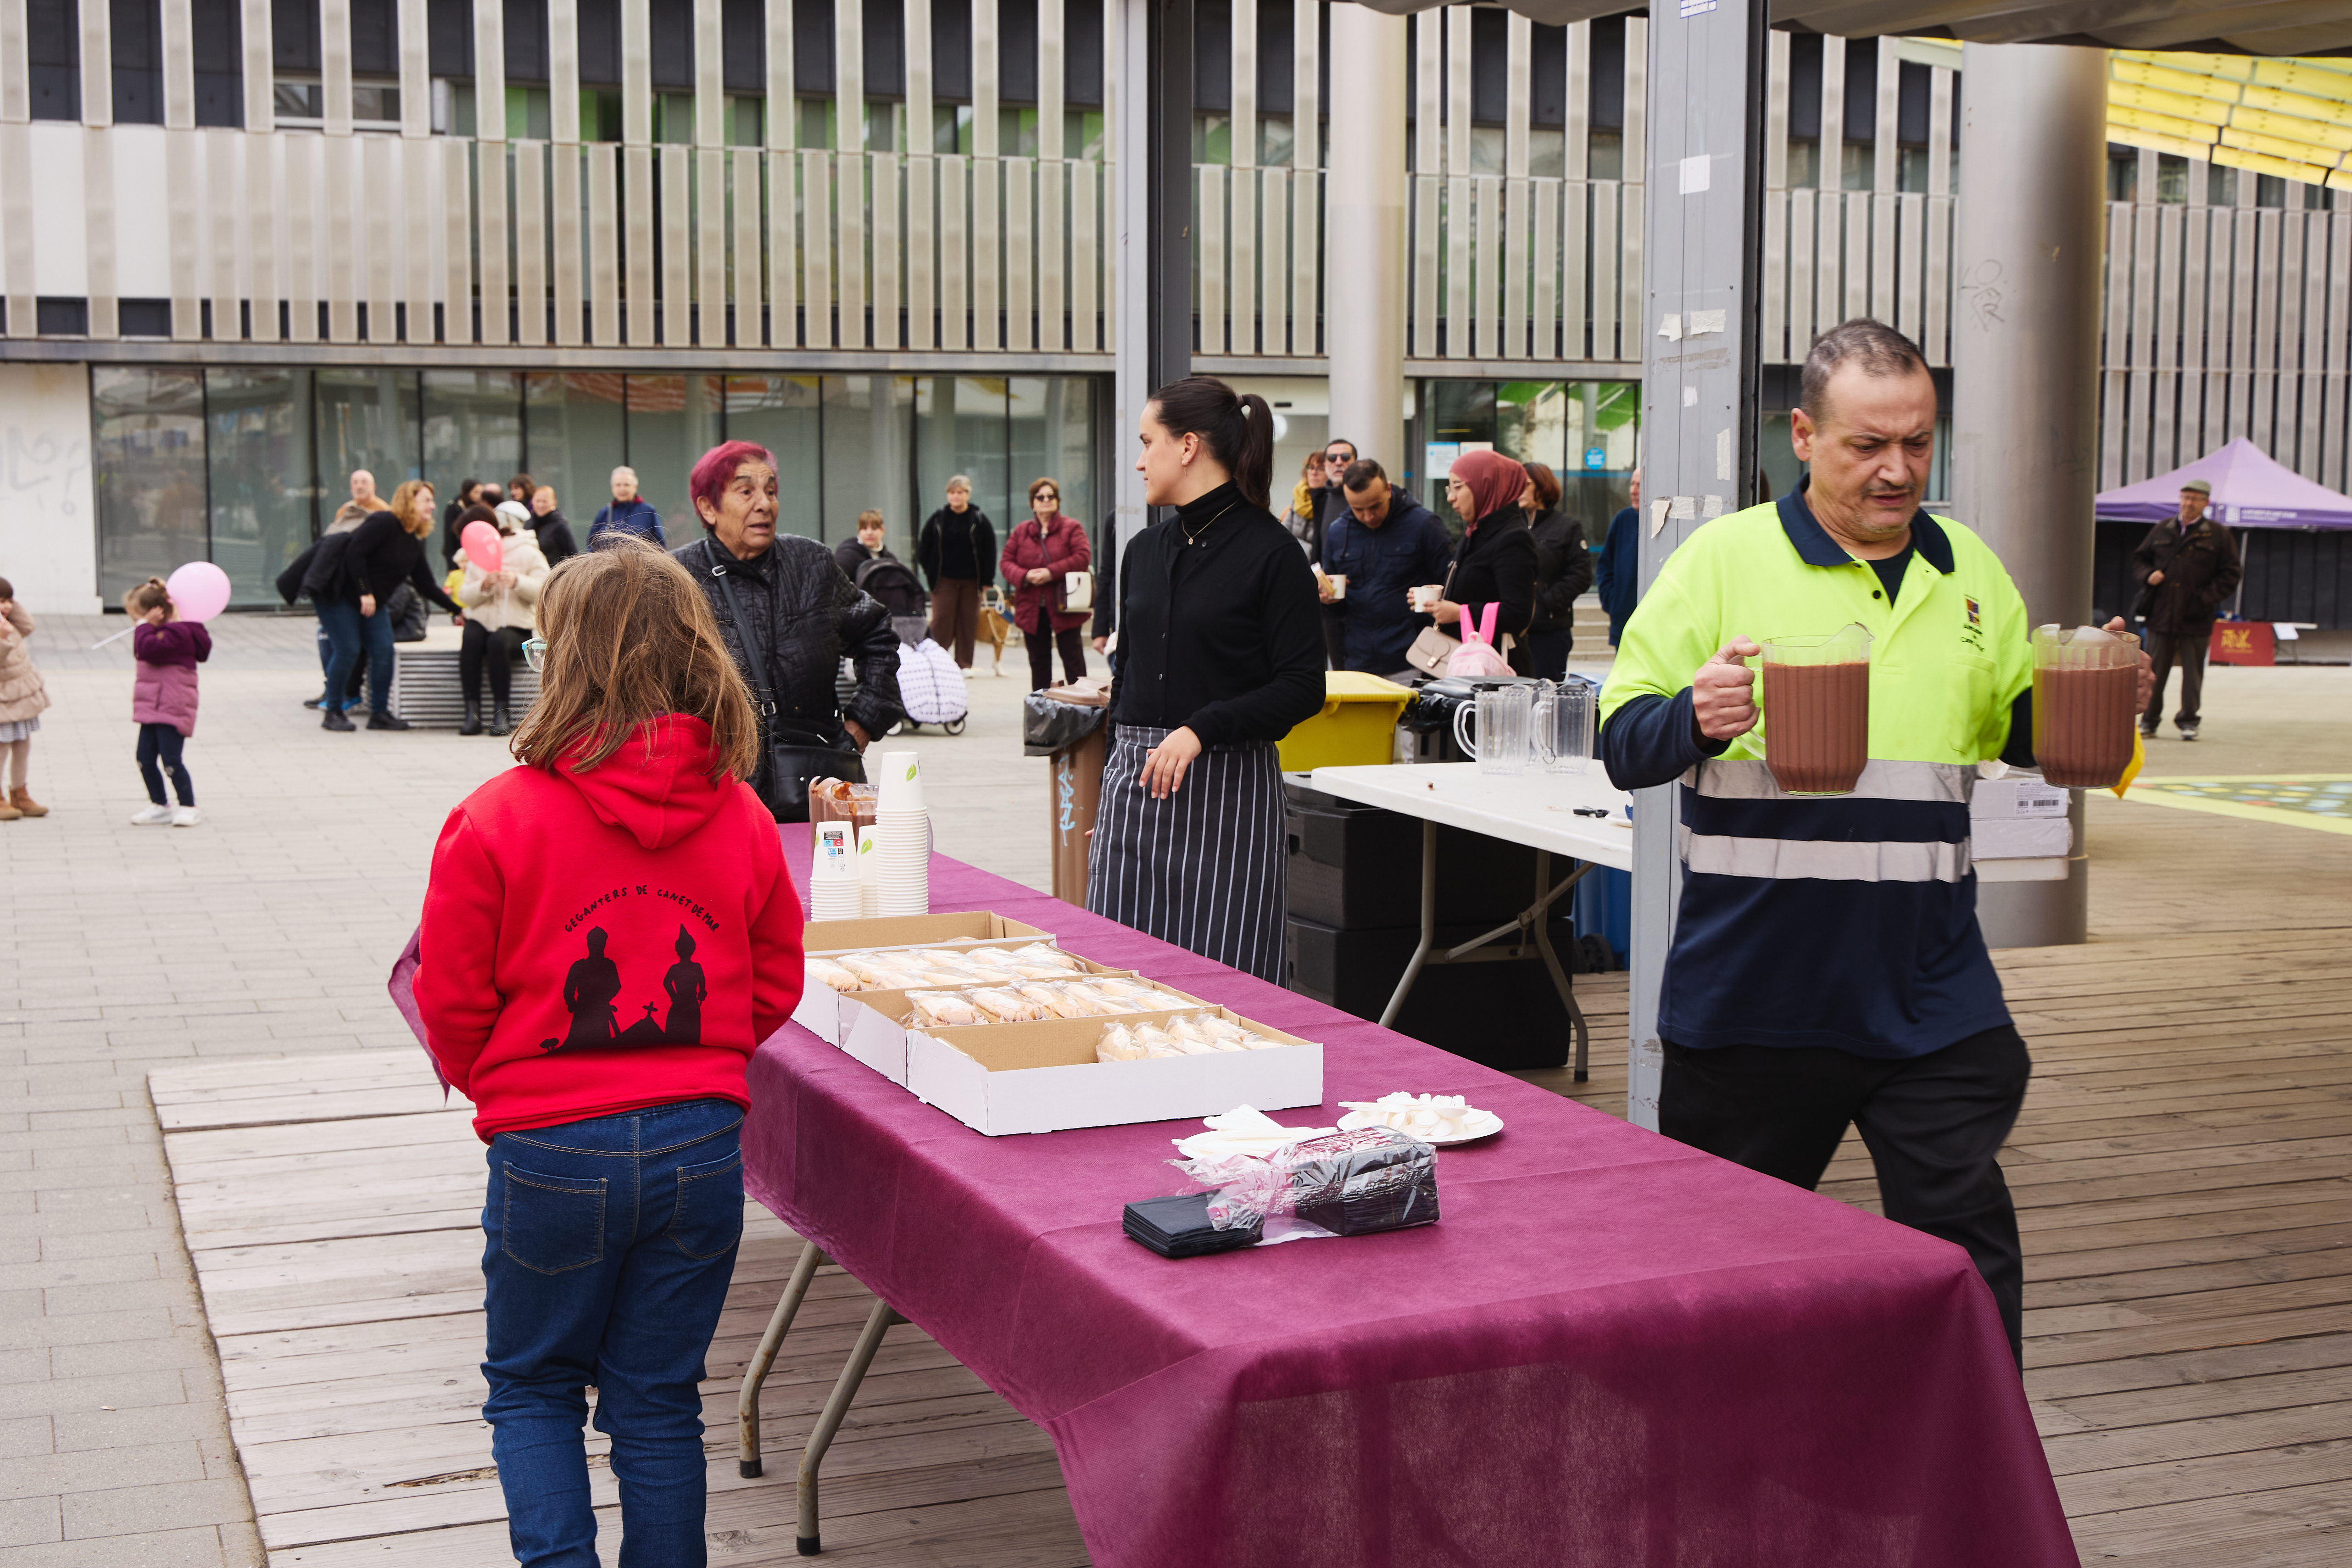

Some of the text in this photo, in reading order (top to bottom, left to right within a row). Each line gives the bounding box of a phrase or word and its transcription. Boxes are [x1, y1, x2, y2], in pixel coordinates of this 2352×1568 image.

[564, 885, 719, 932] GEGANTERS DE CANET DE MAR
